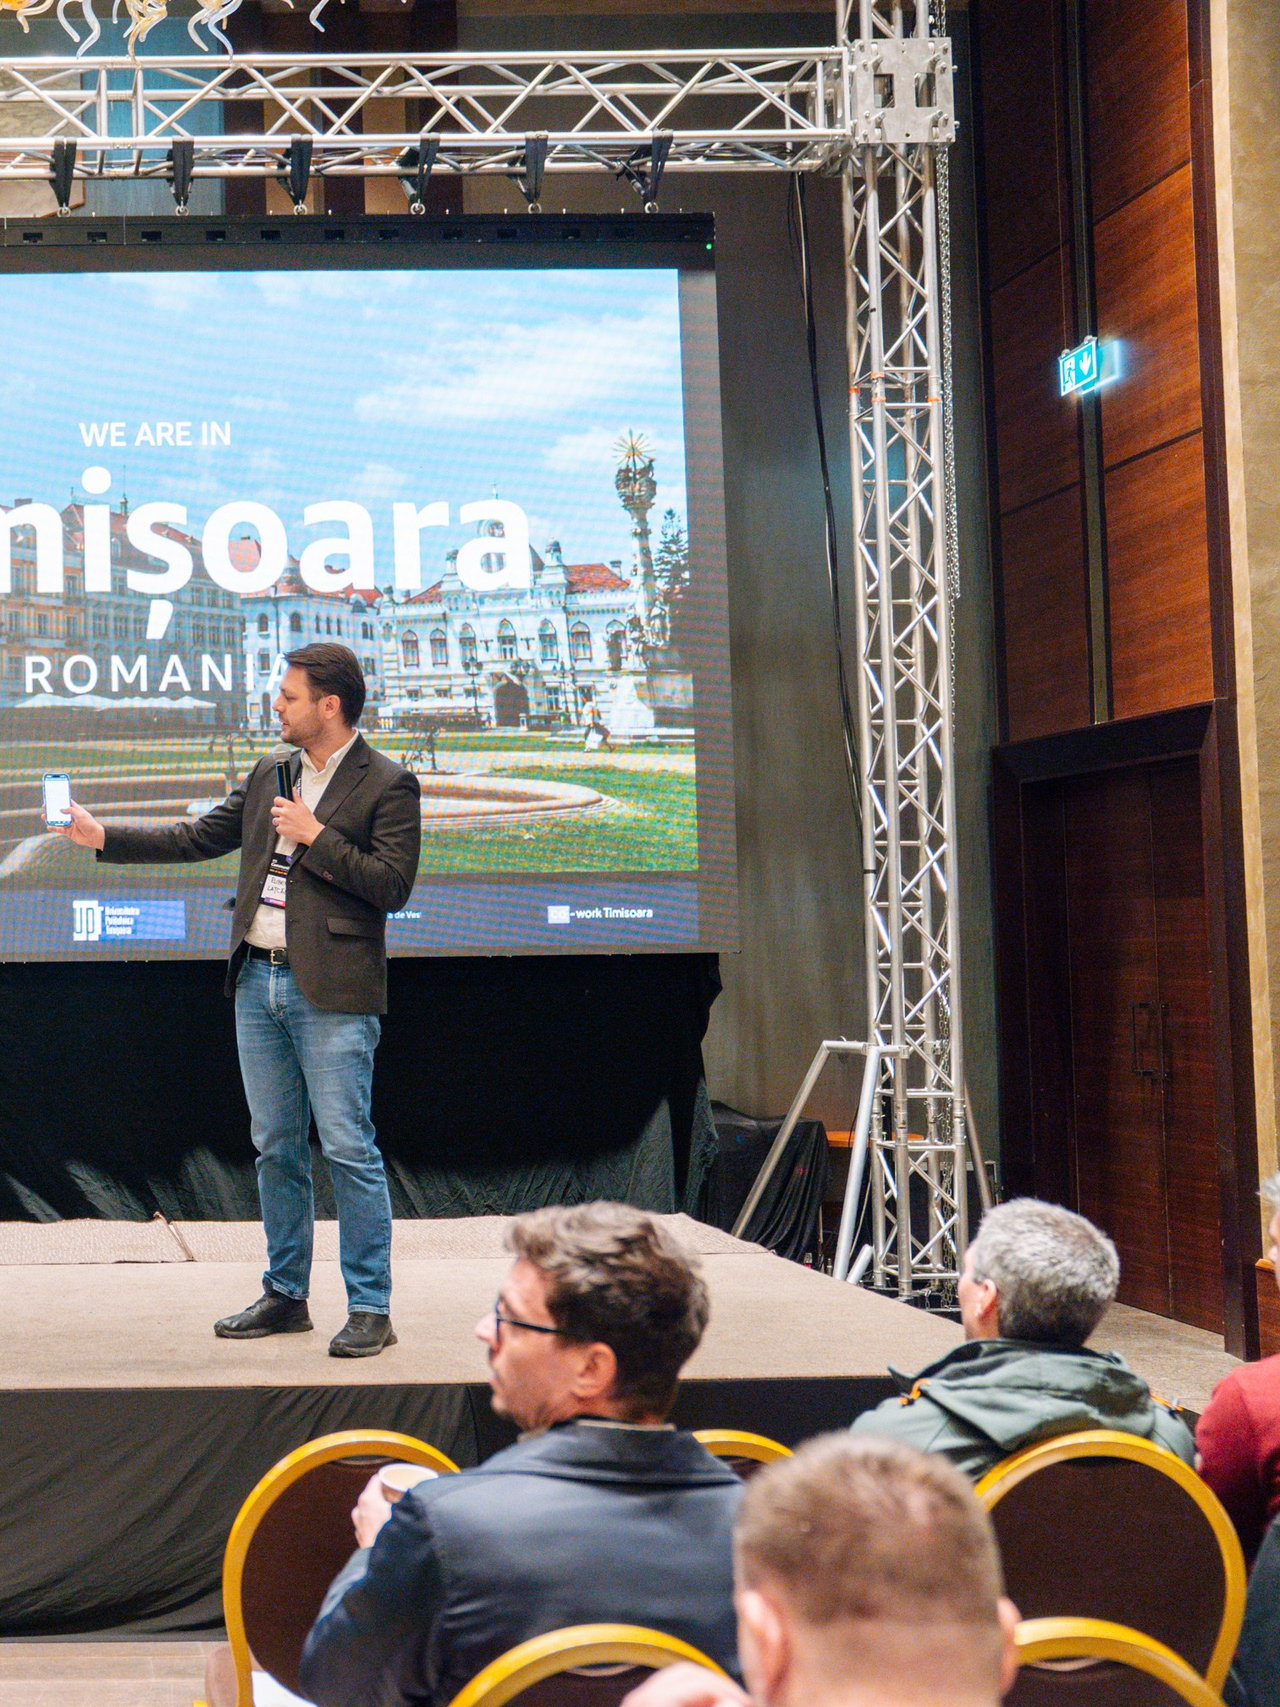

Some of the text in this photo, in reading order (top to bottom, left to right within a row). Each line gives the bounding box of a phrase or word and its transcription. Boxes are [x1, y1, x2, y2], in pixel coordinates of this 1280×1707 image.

[78, 421, 231, 448] WE ARE IN
[602, 907, 654, 919] Timisoara
